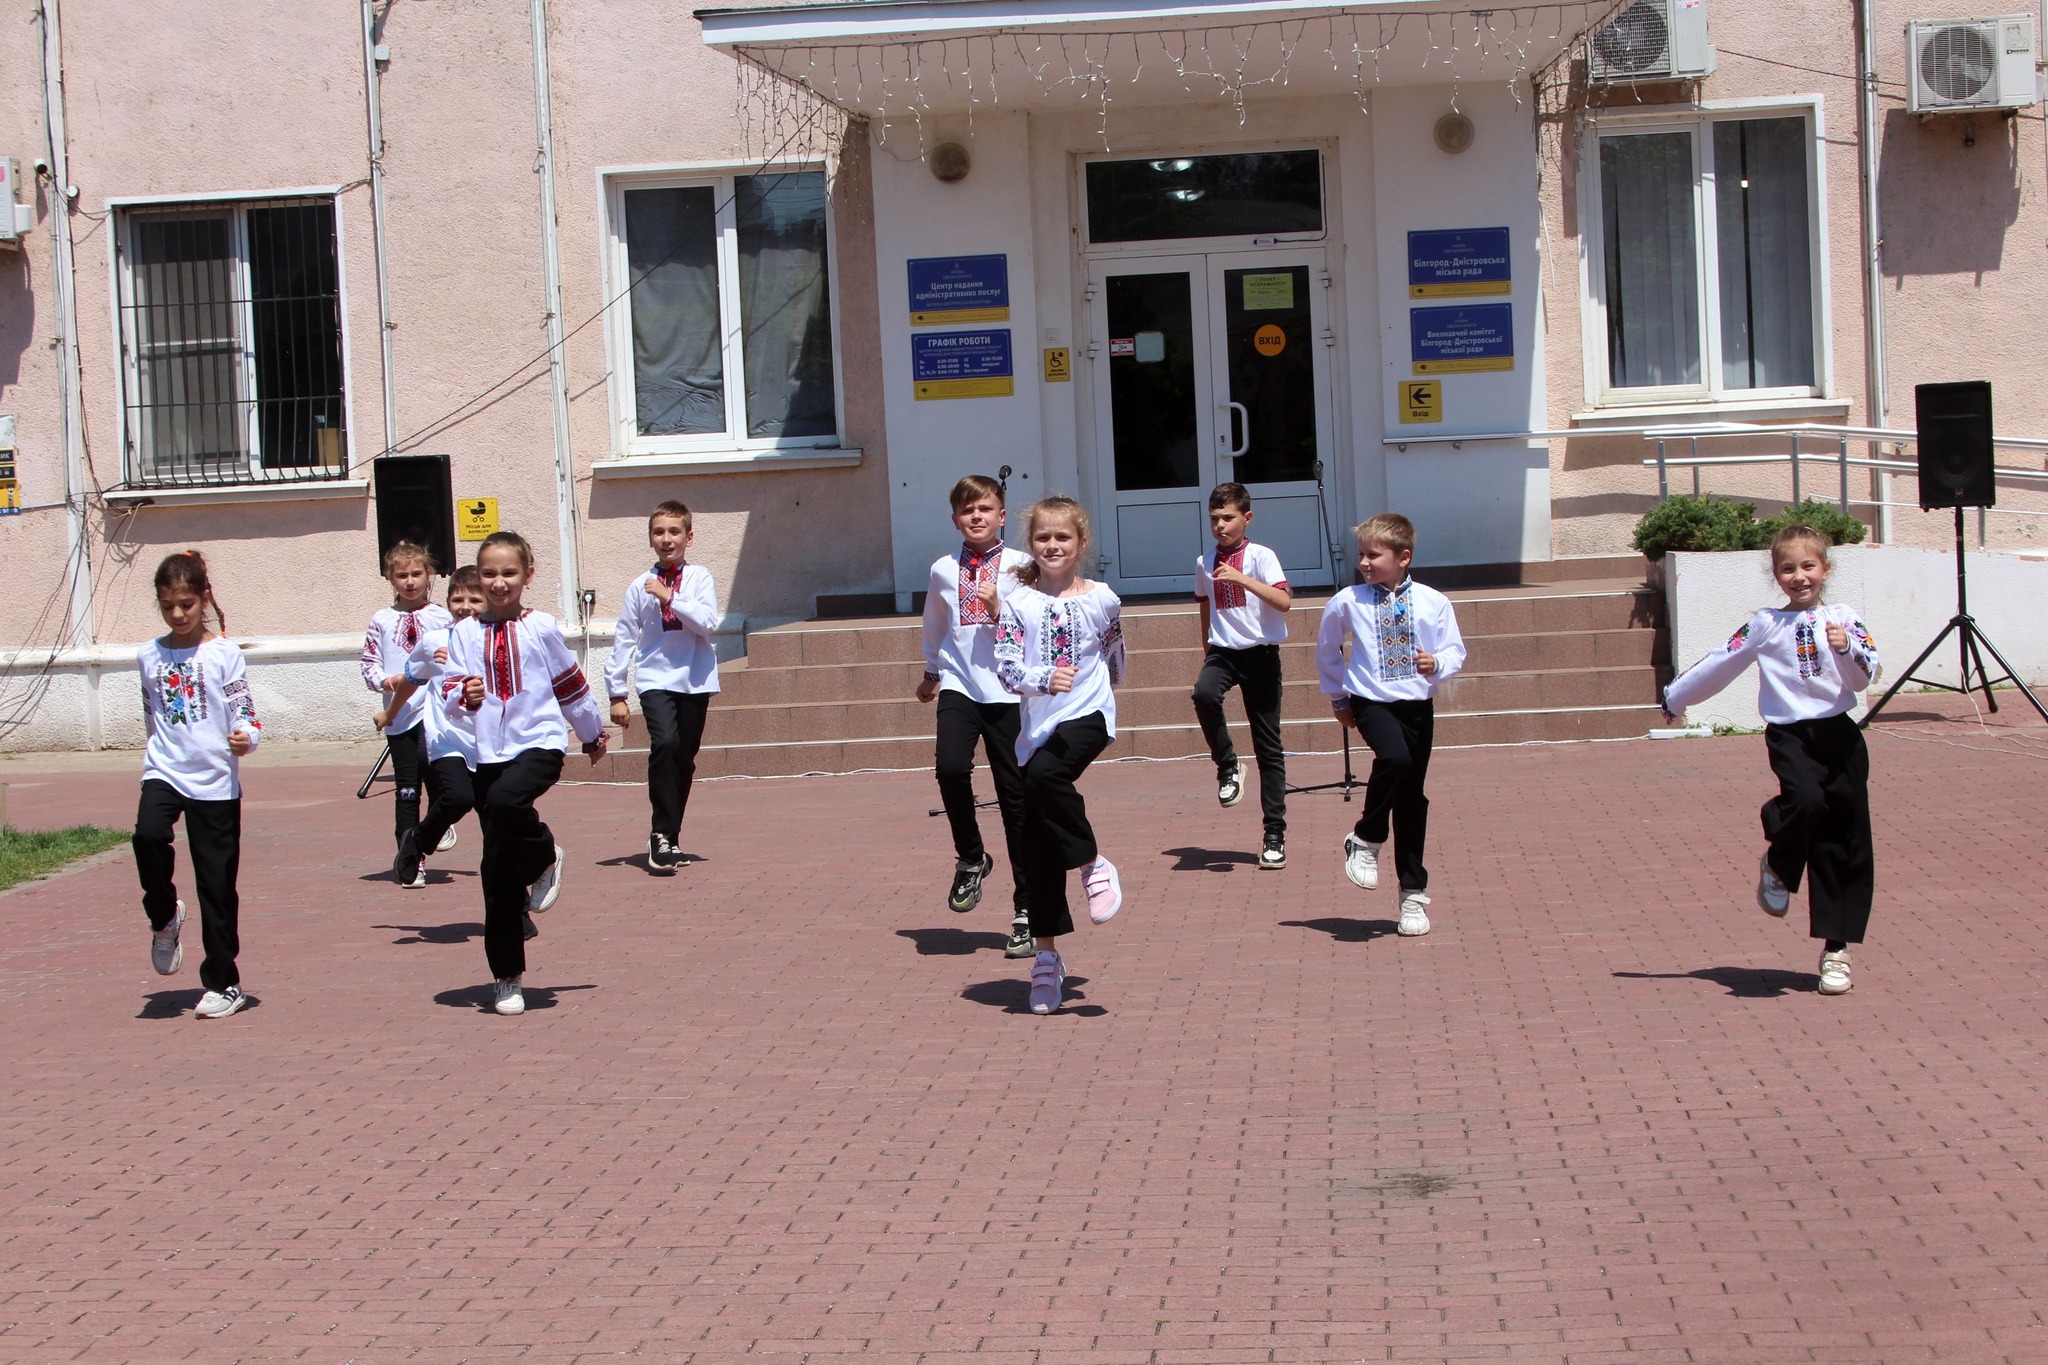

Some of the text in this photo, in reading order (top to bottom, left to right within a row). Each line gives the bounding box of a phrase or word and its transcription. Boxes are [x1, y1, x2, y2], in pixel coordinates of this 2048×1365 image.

[1414, 257, 1505, 268] Білгород-Дністровська
[1436, 268, 1482, 277] міська рада
[916, 290, 976, 300] адміністративних
[1427, 329, 1468, 337] Виконавчий
[928, 337, 991, 347] ГРАФІК РОБОТИ
[1259, 336, 1281, 345] ВХІД
[1421, 336, 1503, 347] Білгород-Дністровської
